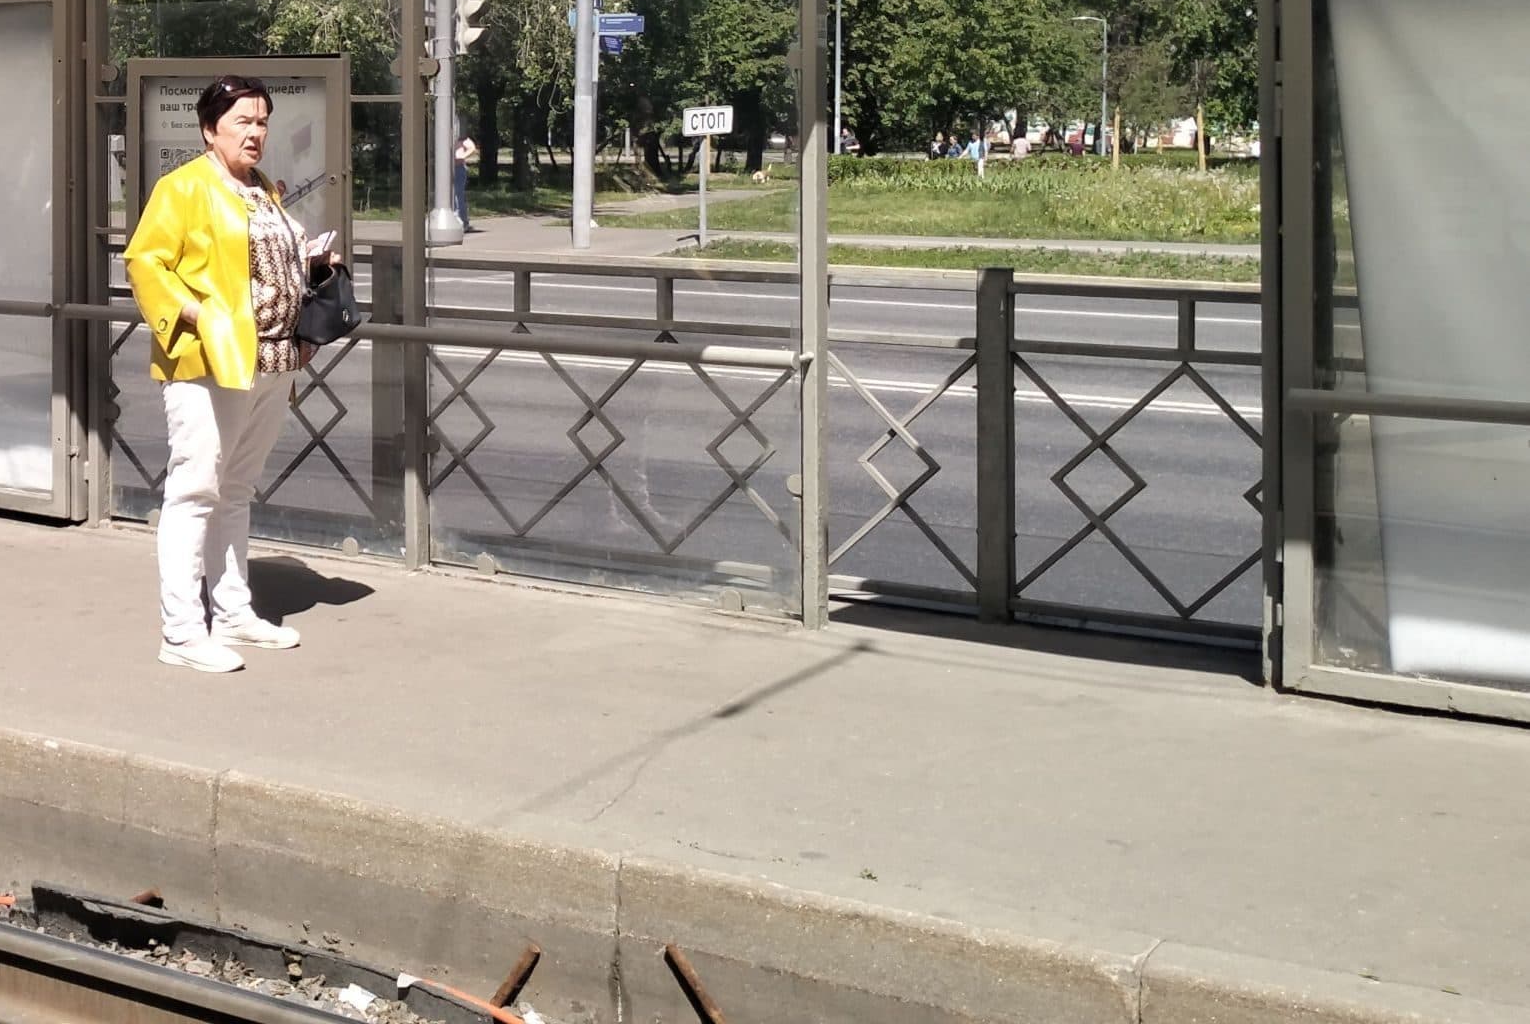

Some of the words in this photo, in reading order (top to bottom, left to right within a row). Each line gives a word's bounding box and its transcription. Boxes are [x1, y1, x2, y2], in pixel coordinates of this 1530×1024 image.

[160, 85, 205, 96] Посмотр
[266, 85, 307, 95] риедет
[160, 103, 180, 112] ваш
[691, 112, 725, 130] СТОП
